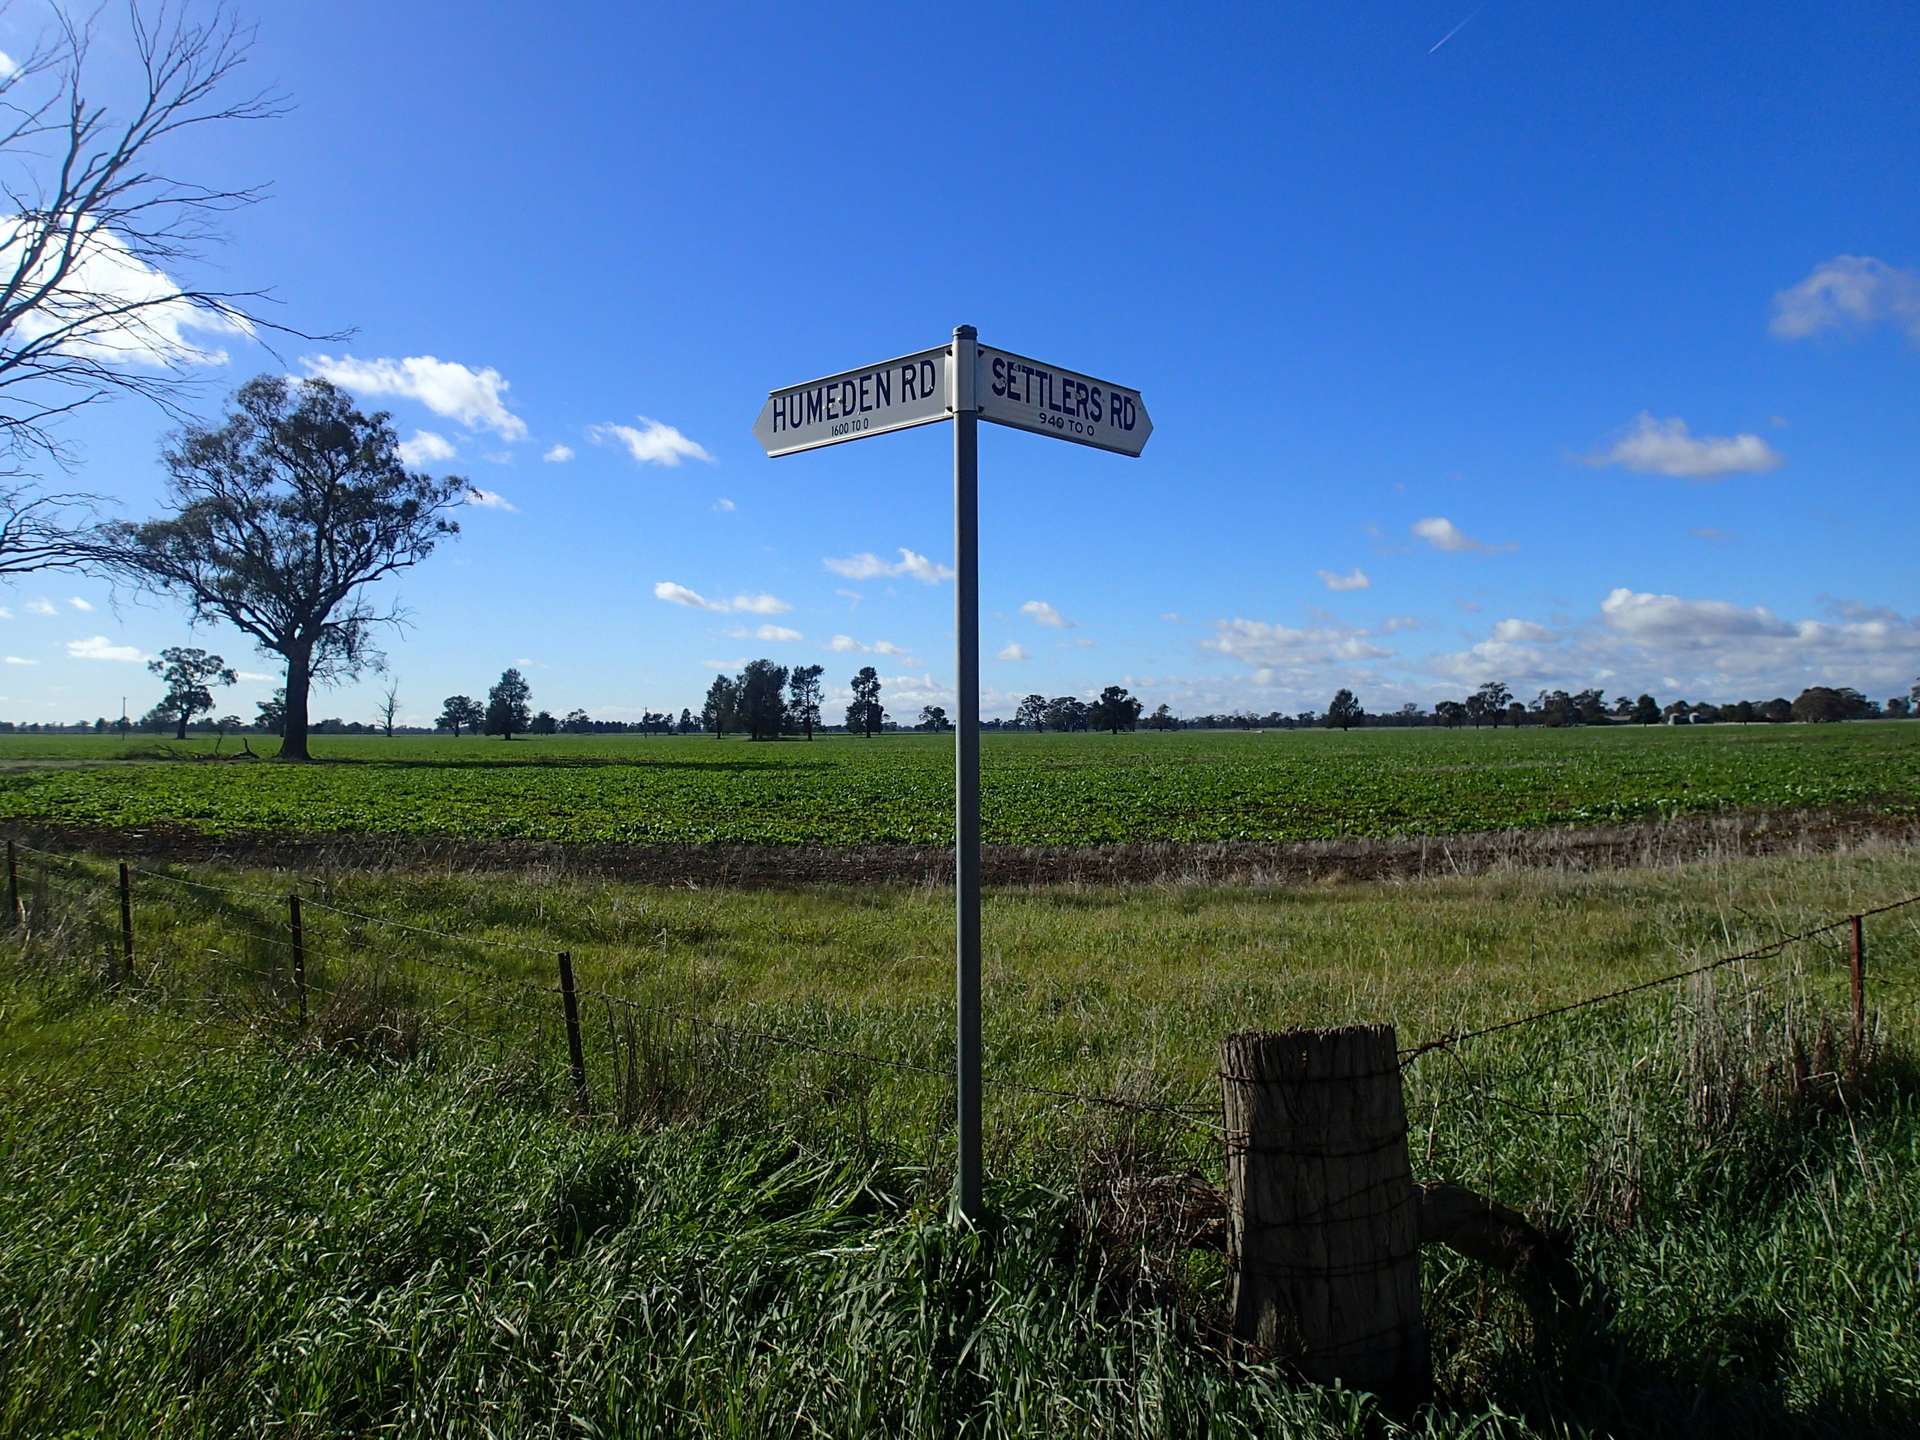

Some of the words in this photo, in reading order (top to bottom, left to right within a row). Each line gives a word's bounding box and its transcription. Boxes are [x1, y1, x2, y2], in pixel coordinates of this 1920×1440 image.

[773, 369, 891, 433] HUMEDEN
[901, 359, 936, 403] RD
[991, 357, 1103, 423] SETTLERS
[1110, 391, 1136, 431] RD
[831, 423, 849, 437] 1600
[852, 420, 861, 432] TO
[1068, 420, 1083, 434] TO
